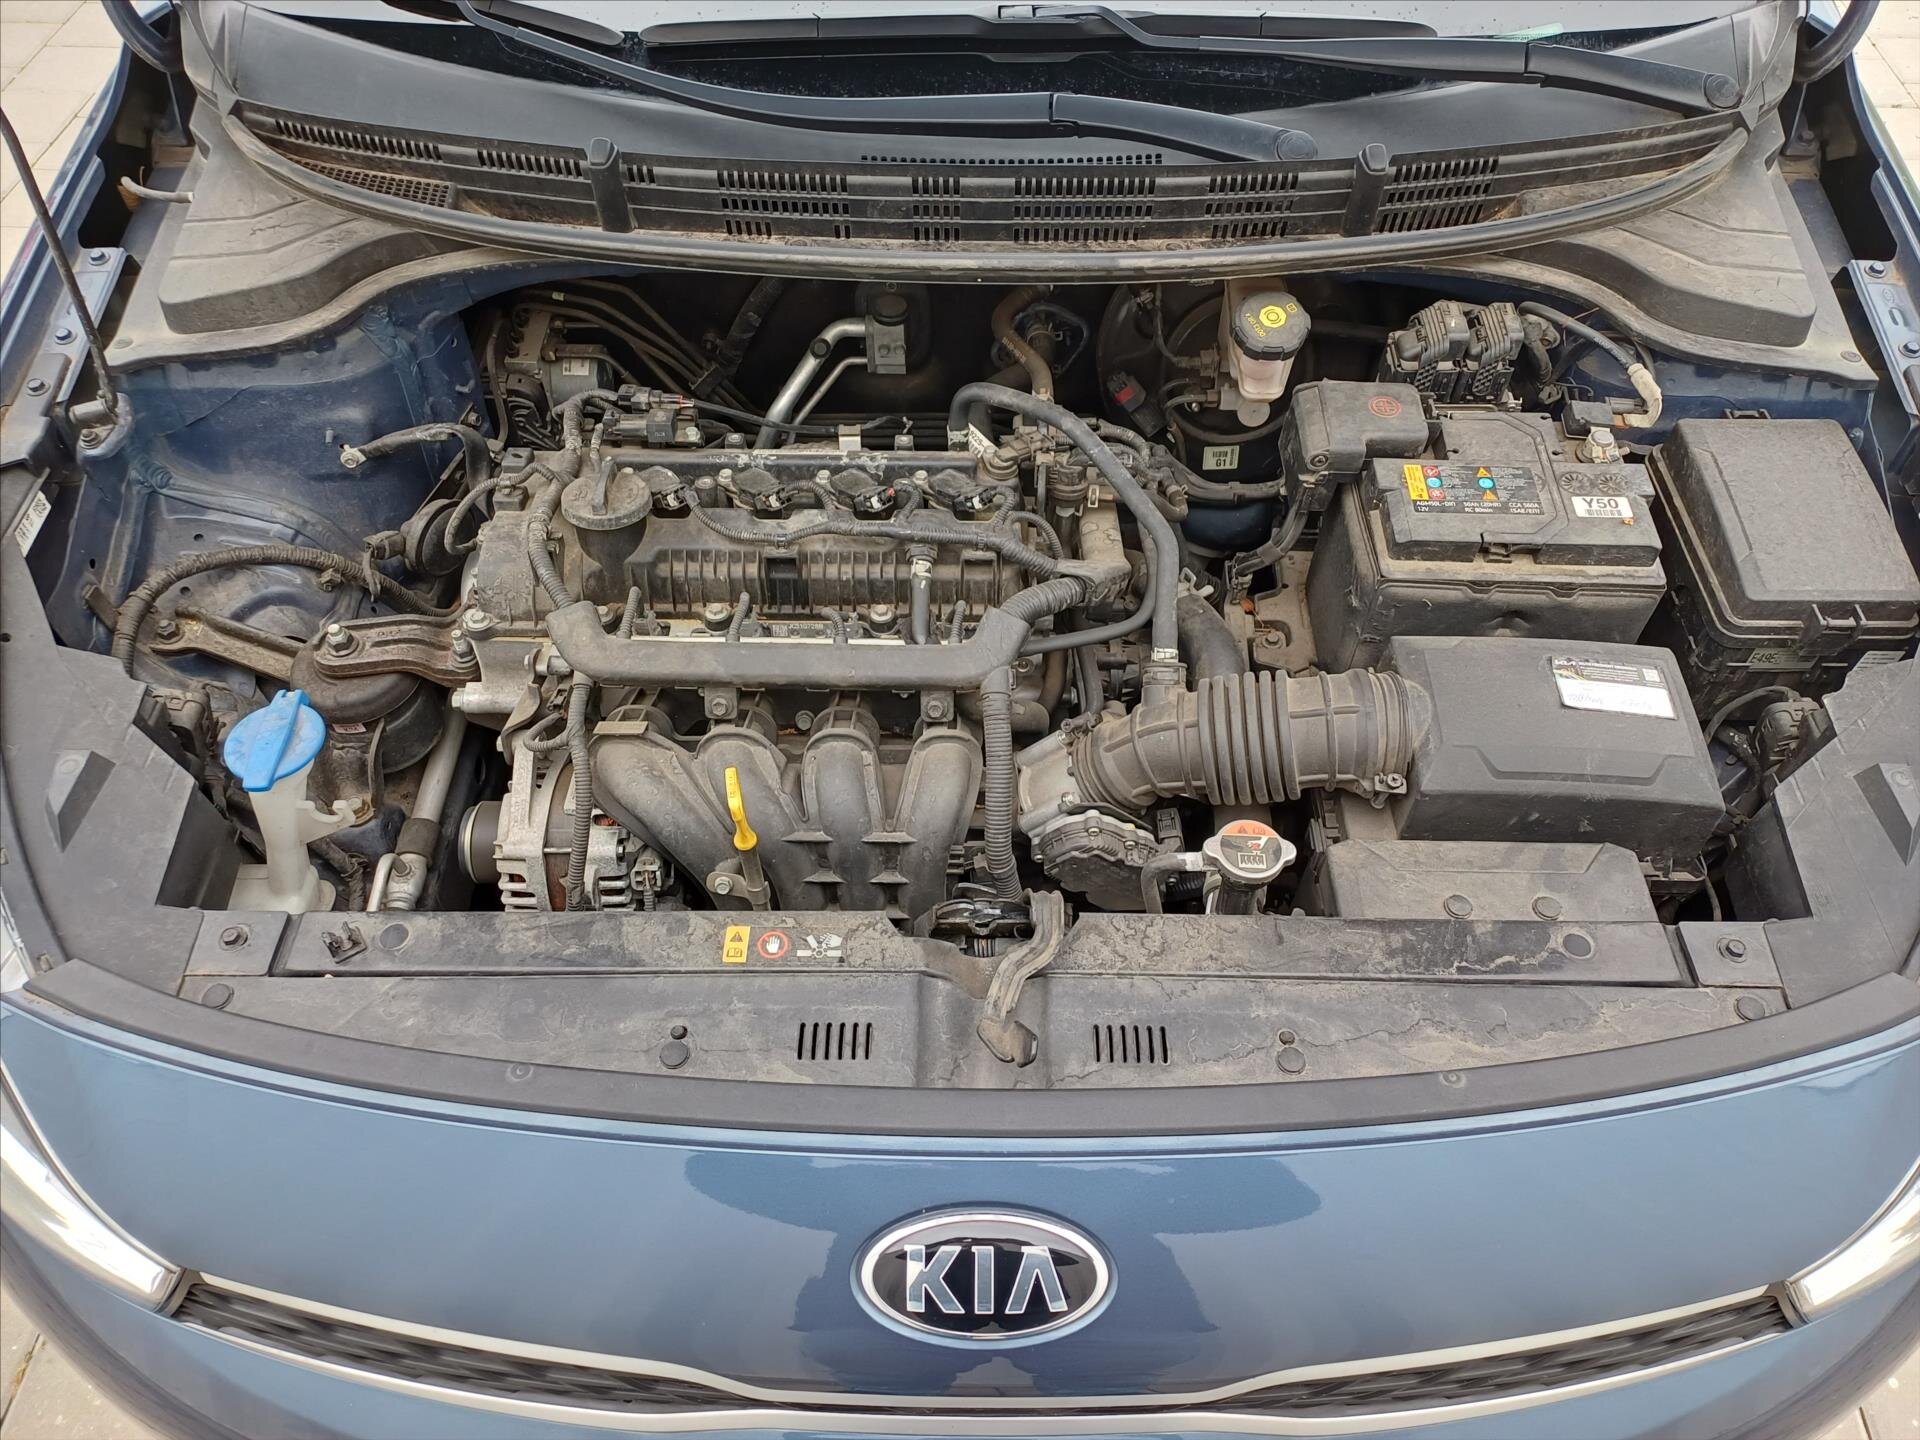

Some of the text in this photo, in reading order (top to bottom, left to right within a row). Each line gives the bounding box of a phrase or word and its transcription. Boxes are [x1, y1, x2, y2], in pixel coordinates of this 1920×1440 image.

[1216, 458, 1227, 467] G1
[1582, 497, 1619, 509] Y50
[903, 1244, 1069, 1315] KIA
